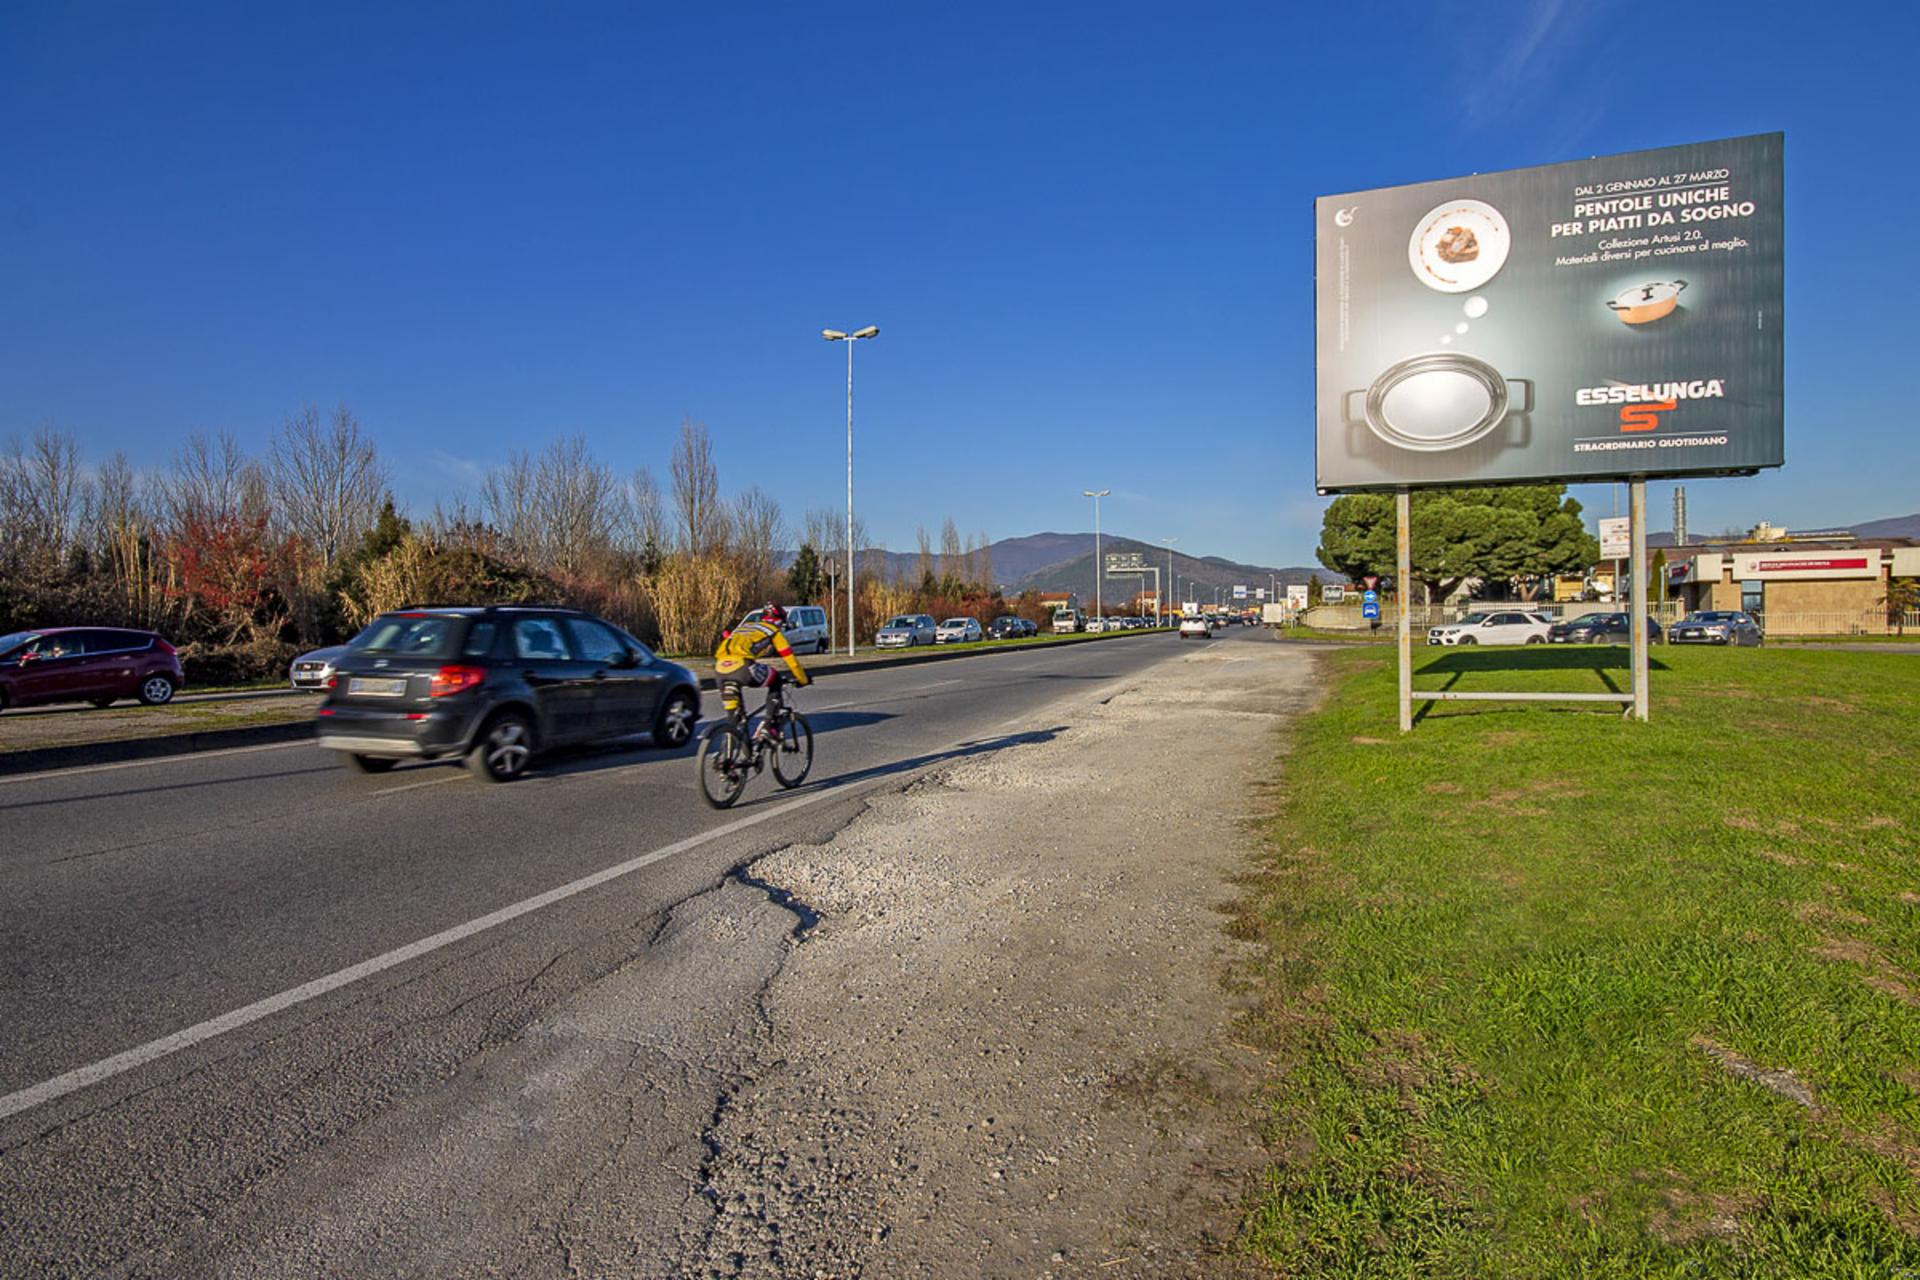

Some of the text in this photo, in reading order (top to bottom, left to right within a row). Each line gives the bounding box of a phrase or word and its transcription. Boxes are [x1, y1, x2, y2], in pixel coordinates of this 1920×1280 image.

[1575, 169, 1729, 196] DAL 2 GENNAIO AL 27 MARZO
[1574, 187, 1729, 218] PENTOLE UNICHE
[1551, 202, 1755, 237] PER PIATTI DA SOGNO
[1555, 254, 1598, 266] Materiali
[1601, 249, 1632, 262] diversi
[1635, 249, 1651, 261] per
[1654, 244, 1696, 256] cucinare
[1699, 241, 1709, 250] al
[1598, 235, 1649, 250] Collezione
[1576, 380, 1724, 405] ESSELUNGA
[1574, 436, 1728, 452] STRAORDINARIO QUOTIDIANO
